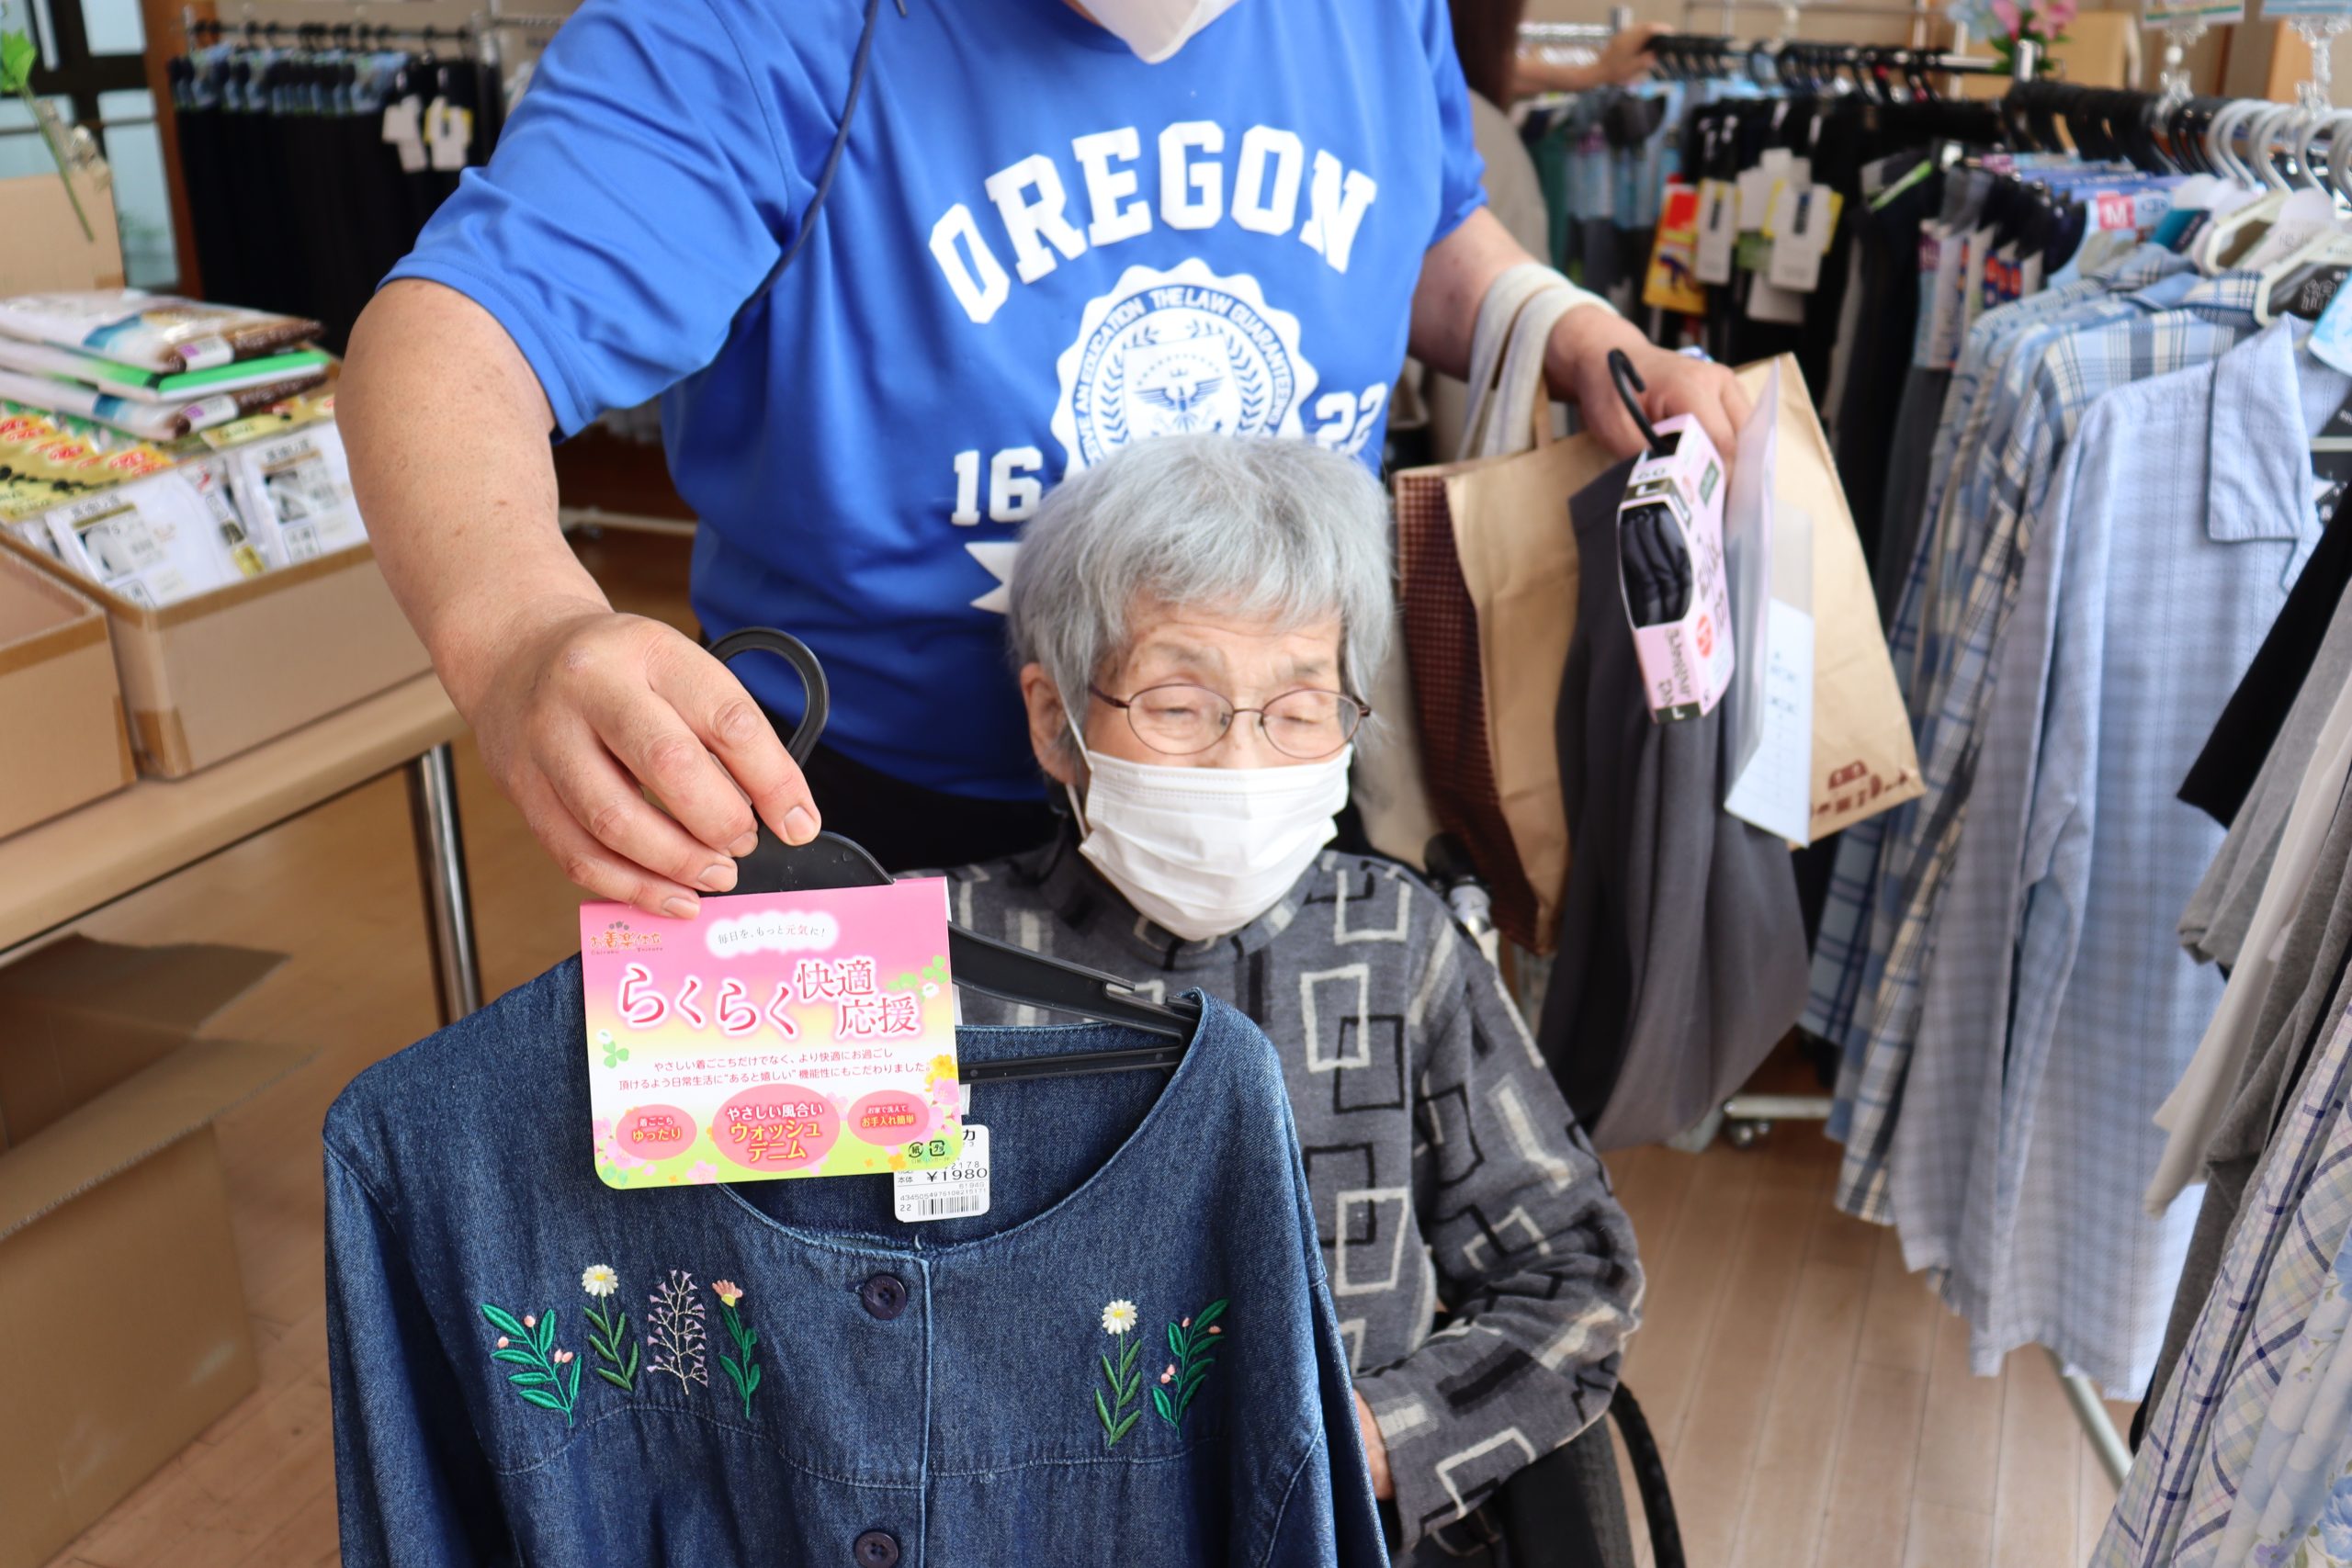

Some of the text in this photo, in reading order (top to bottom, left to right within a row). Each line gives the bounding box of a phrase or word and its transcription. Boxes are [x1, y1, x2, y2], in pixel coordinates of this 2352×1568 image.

[929, 120, 1377, 324] OREGON
[1149, 287, 1184, 310] THE
[1184, 288, 1233, 317] LAW
[1080, 297, 1147, 384] EDUCATION
[1229, 302, 1292, 426] GUARANTEEING
[1075, 382, 1091, 413] AN
[951, 382, 1387, 525] 16 22
[1671, 706, 1685, 720] L
[797, 960, 876, 1000] 快適
[621, 966, 796, 1036] らくらく
[839, 996, 919, 1037] 応援
[653, 1047, 894, 1072] やさしい着ごこちだけでなく、より快適にお過ごし
[639, 1116, 674, 1127] 着ごこち
[727, 1102, 824, 1122] やさしい風合い
[861, 1114, 916, 1129] お手入れ簡単
[631, 1129, 682, 1142] ゆったり
[730, 1122, 822, 1144] ウォッシュ
[748, 1140, 807, 1163] デニム
[926, 1168, 988, 1182] ¥1980
[945, 1161, 979, 1170] 2178
